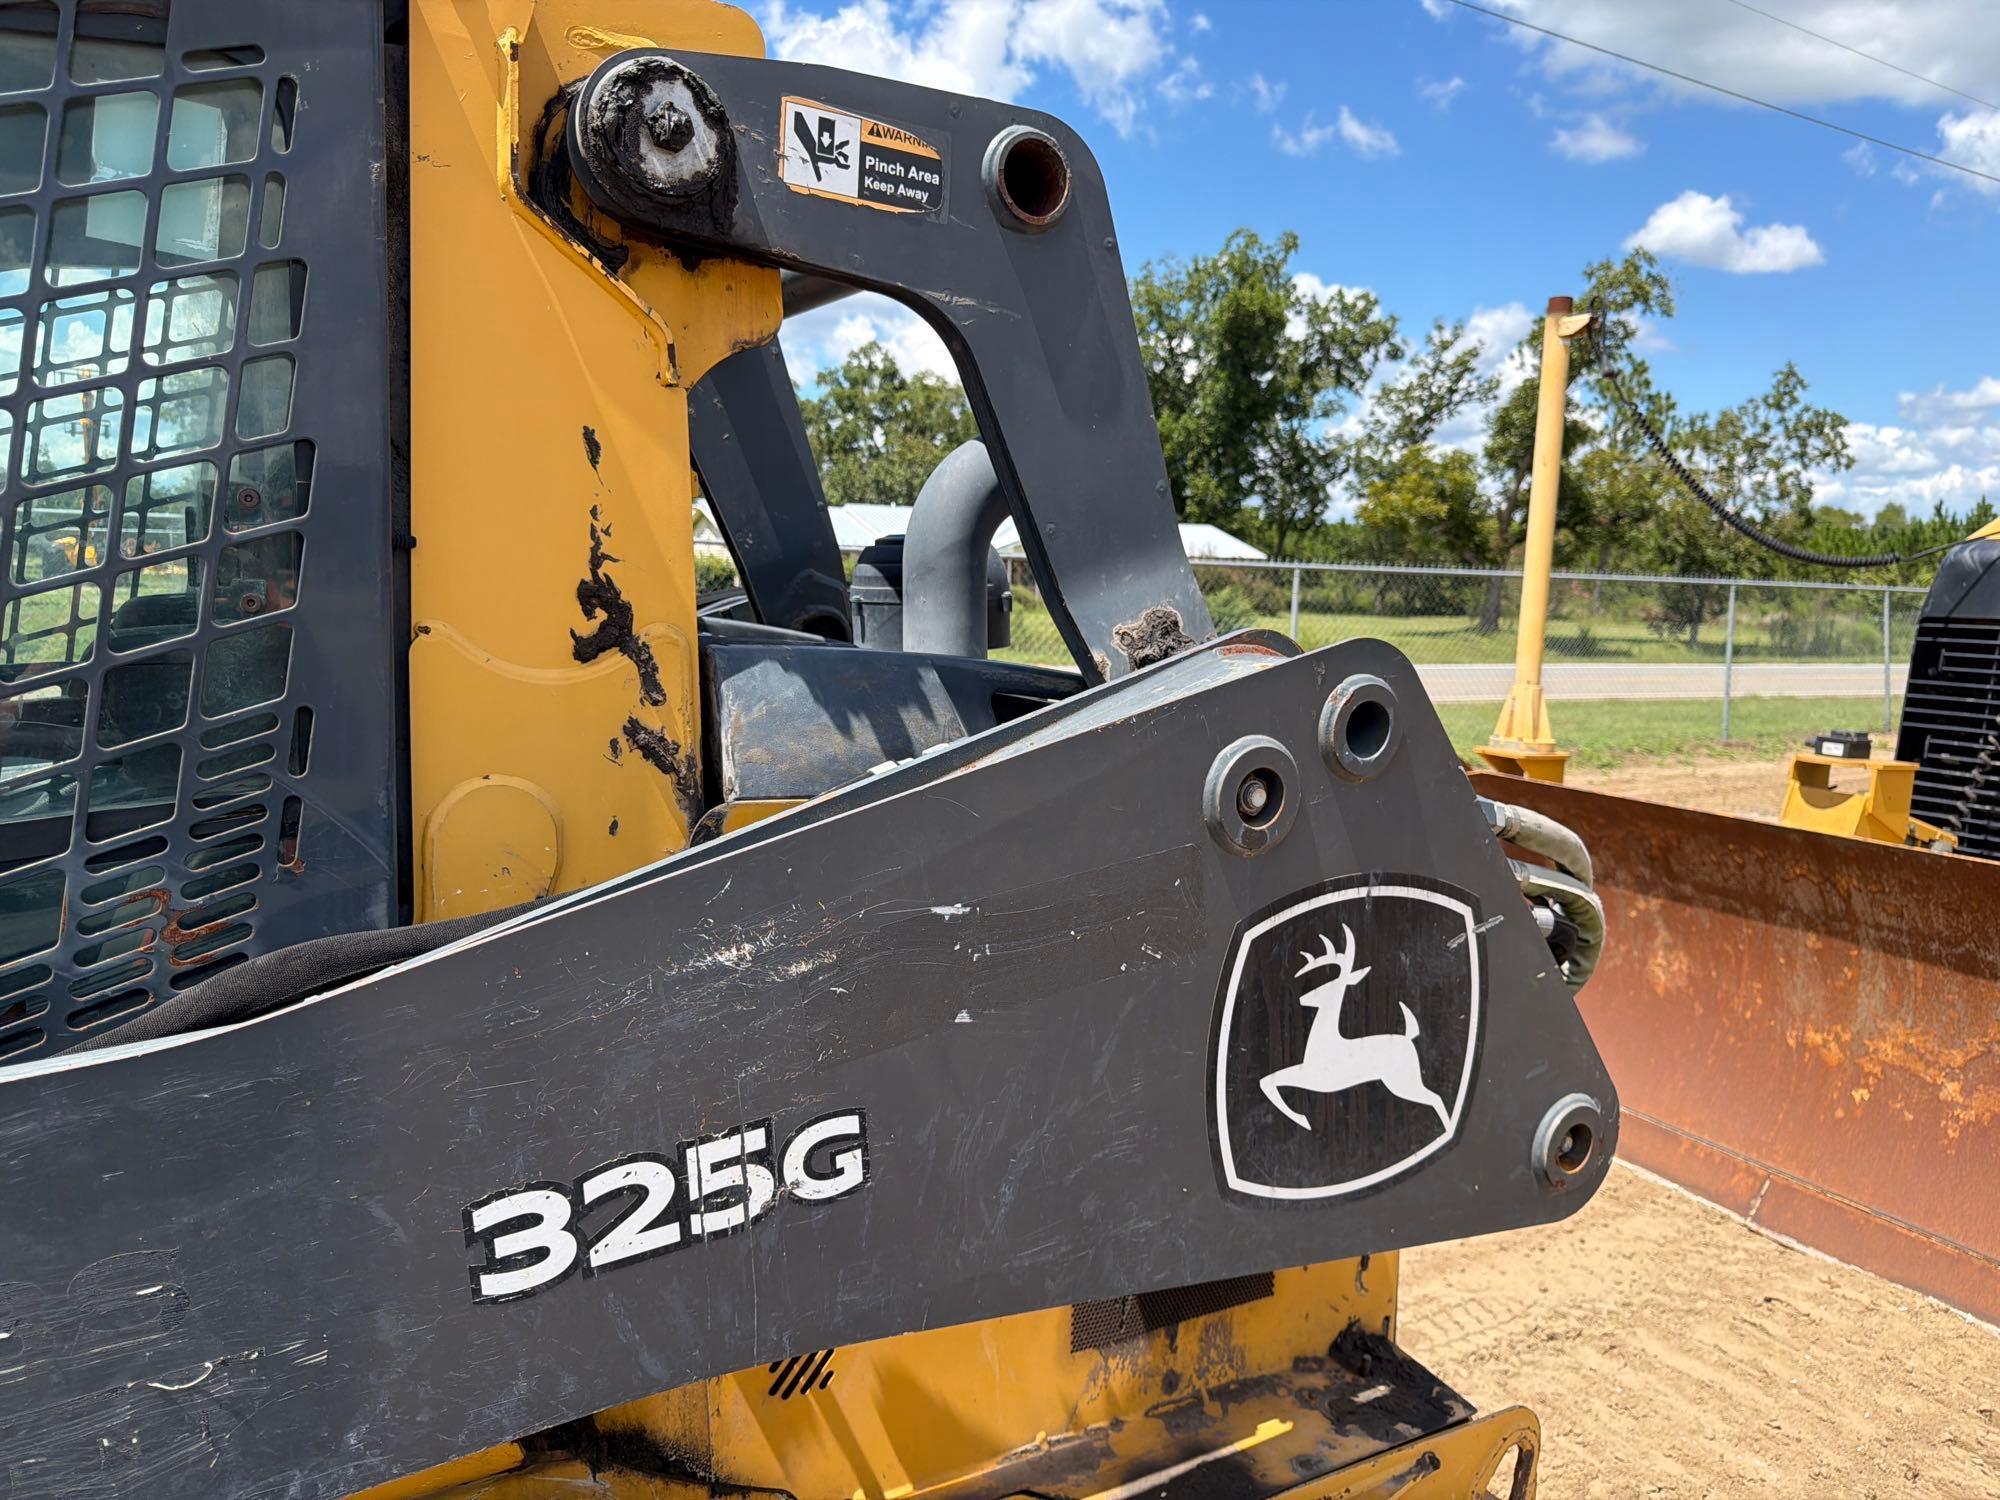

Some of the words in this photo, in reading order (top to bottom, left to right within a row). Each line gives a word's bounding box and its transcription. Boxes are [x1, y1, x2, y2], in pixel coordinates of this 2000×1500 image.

[882, 126, 934, 150] WARN
[865, 155, 905, 177] Pinch
[907, 166, 940, 185] Area
[864, 176, 895, 195] Keep
[897, 184, 929, 203] Away
[469, 1112, 866, 1298] 325G
